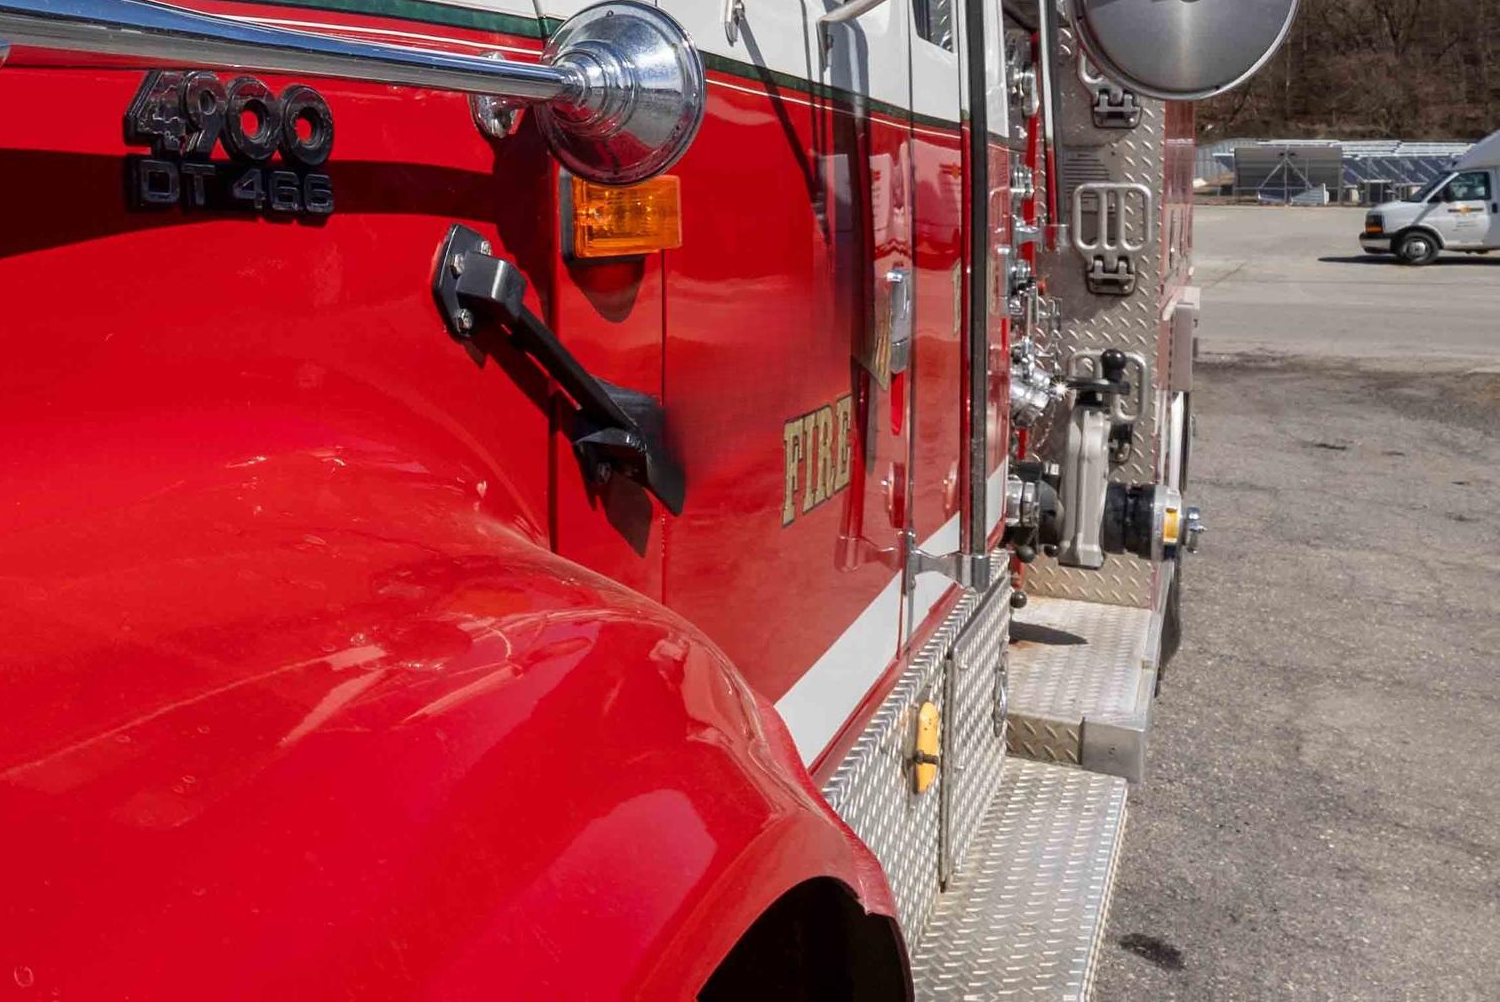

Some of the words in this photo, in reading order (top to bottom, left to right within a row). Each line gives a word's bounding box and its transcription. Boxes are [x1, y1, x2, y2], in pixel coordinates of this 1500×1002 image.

[123, 69, 333, 165] 4900
[138, 159, 217, 206] DT
[233, 167, 334, 215] 466
[782, 393, 852, 527] FIRE
